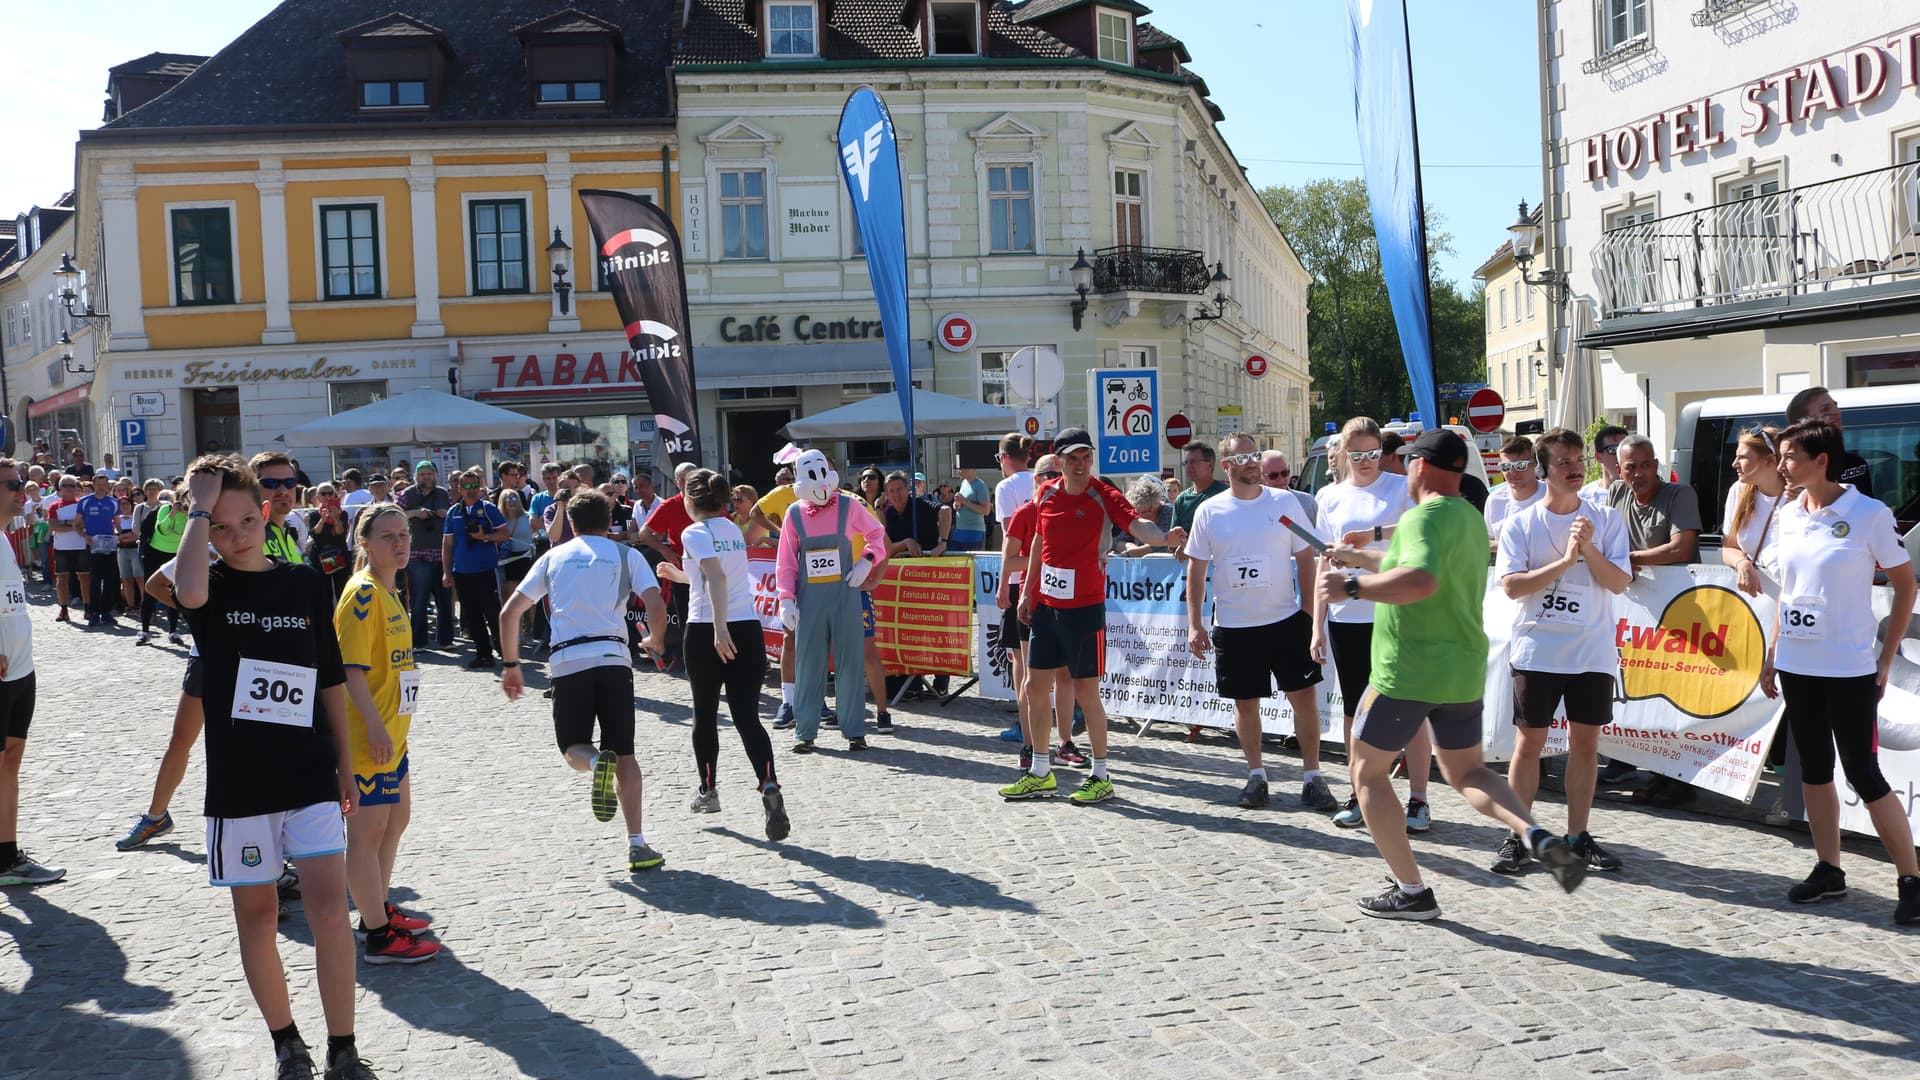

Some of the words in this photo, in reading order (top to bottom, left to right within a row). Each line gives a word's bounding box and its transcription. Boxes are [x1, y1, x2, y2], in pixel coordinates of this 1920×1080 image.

[1583, 97, 1725, 184] HOTEL
[688, 193, 701, 253] HOTEL
[788, 208, 830, 220] Markus
[720, 315, 781, 343] Café
[124, 369, 174, 380] HERREN
[184, 357, 360, 385] Frisiersalon
[491, 351, 641, 388] TABAK
[126, 421, 141, 444] P
[1028, 418, 1037, 432] H
[1131, 413, 1151, 433] 20
[1108, 445, 1151, 463] Zone
[811, 558, 835, 569] 32c
[1043, 573, 1068, 590] 22c
[1238, 566, 1260, 581] 7c
[5, 590, 24, 604] 16a
[936, 592, 951, 601] Glas
[1542, 594, 1580, 614] 35c
[1784, 609, 1815, 628] 13c
[1126, 622, 1138, 636] für
[1132, 639, 1167, 653] befugter
[1168, 641, 1186, 654] und
[1124, 652, 1164, 668] Allgemein
[1166, 656, 1212, 671] beeideter
[249, 677, 304, 705] 30c
[1111, 672, 1168, 692] Wieselburg
[405, 685, 419, 702] 17
[1100, 686, 1130, 701] 55100
[1136, 690, 1157, 705] Fax
[1159, 692, 1180, 707] DW
[1180, 695, 1192, 709] 20
[1684, 732, 1762, 756] Gottwald
